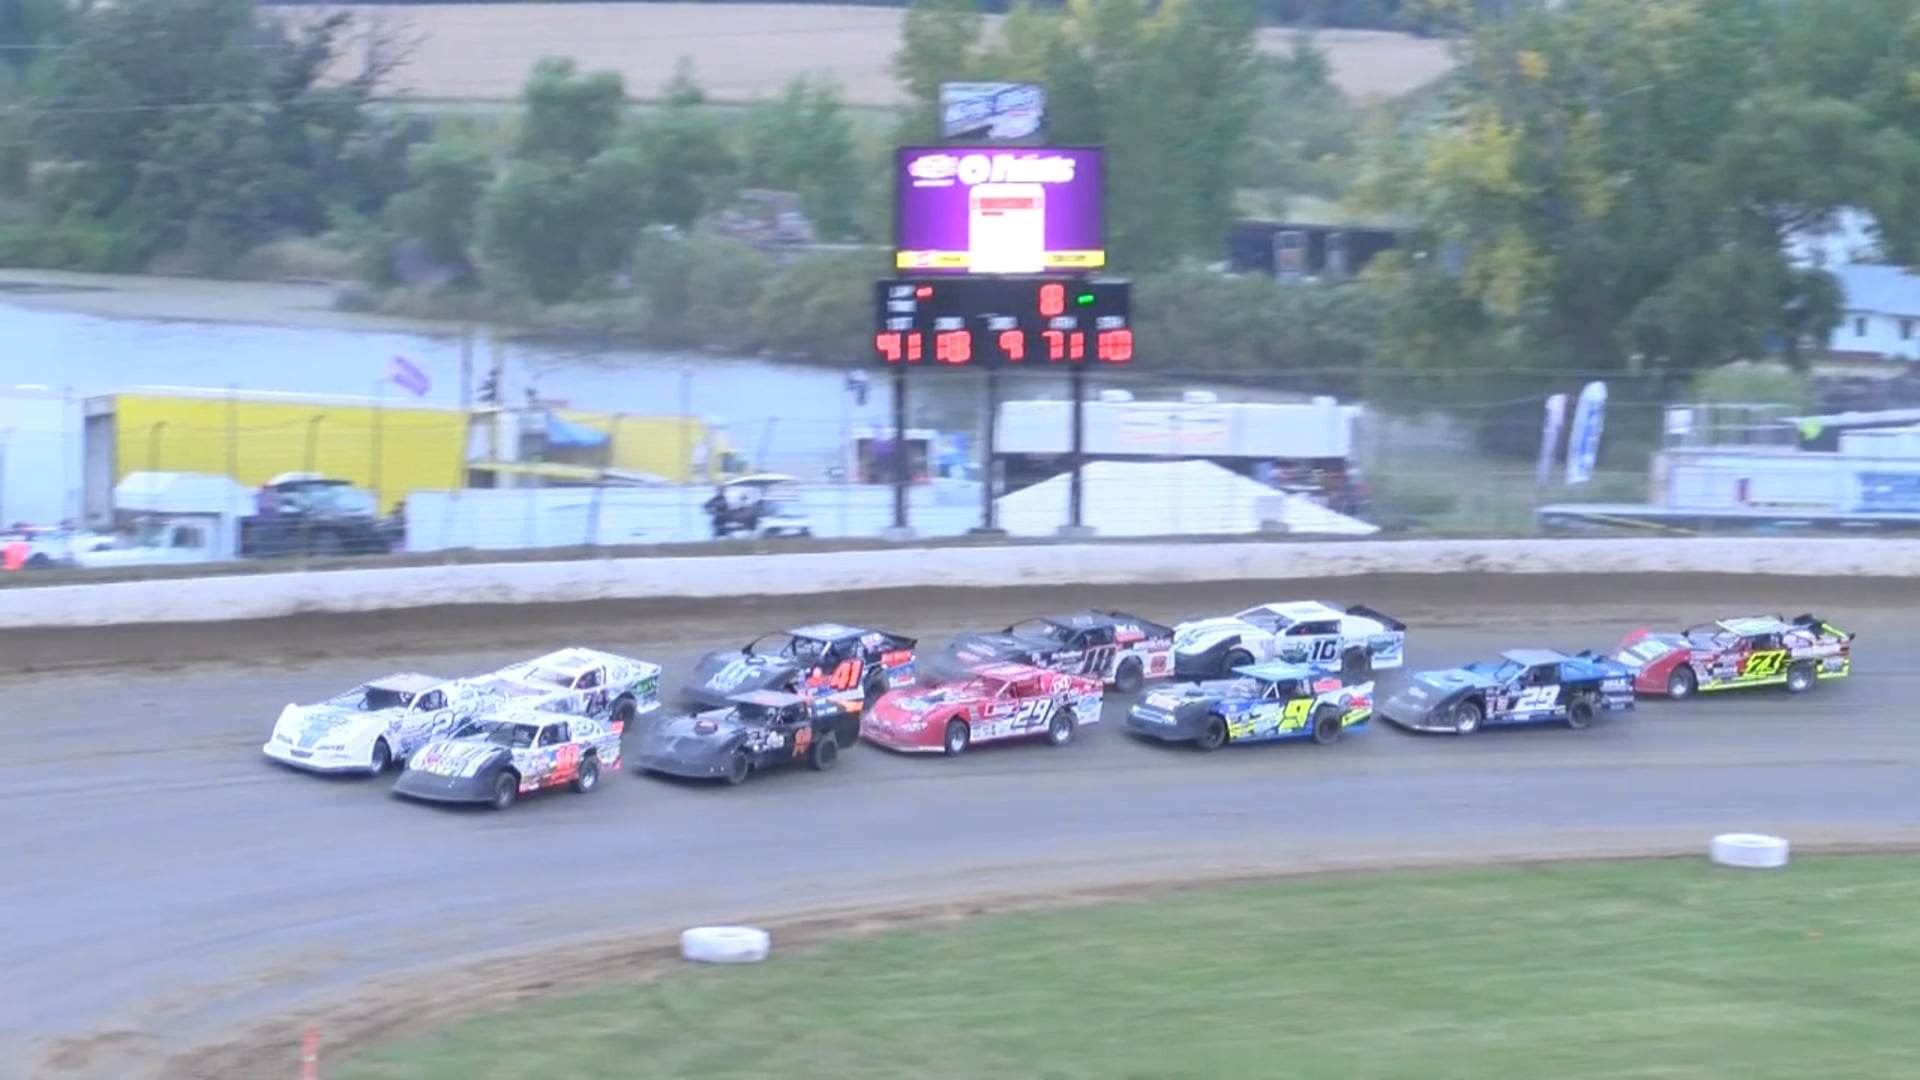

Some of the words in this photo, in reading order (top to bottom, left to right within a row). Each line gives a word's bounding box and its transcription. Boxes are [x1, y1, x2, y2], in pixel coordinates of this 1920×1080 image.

[829, 659, 864, 691] 41
[1012, 698, 1054, 728] 29
[1514, 684, 1561, 711] 29
[1278, 699, 1315, 734] 9
